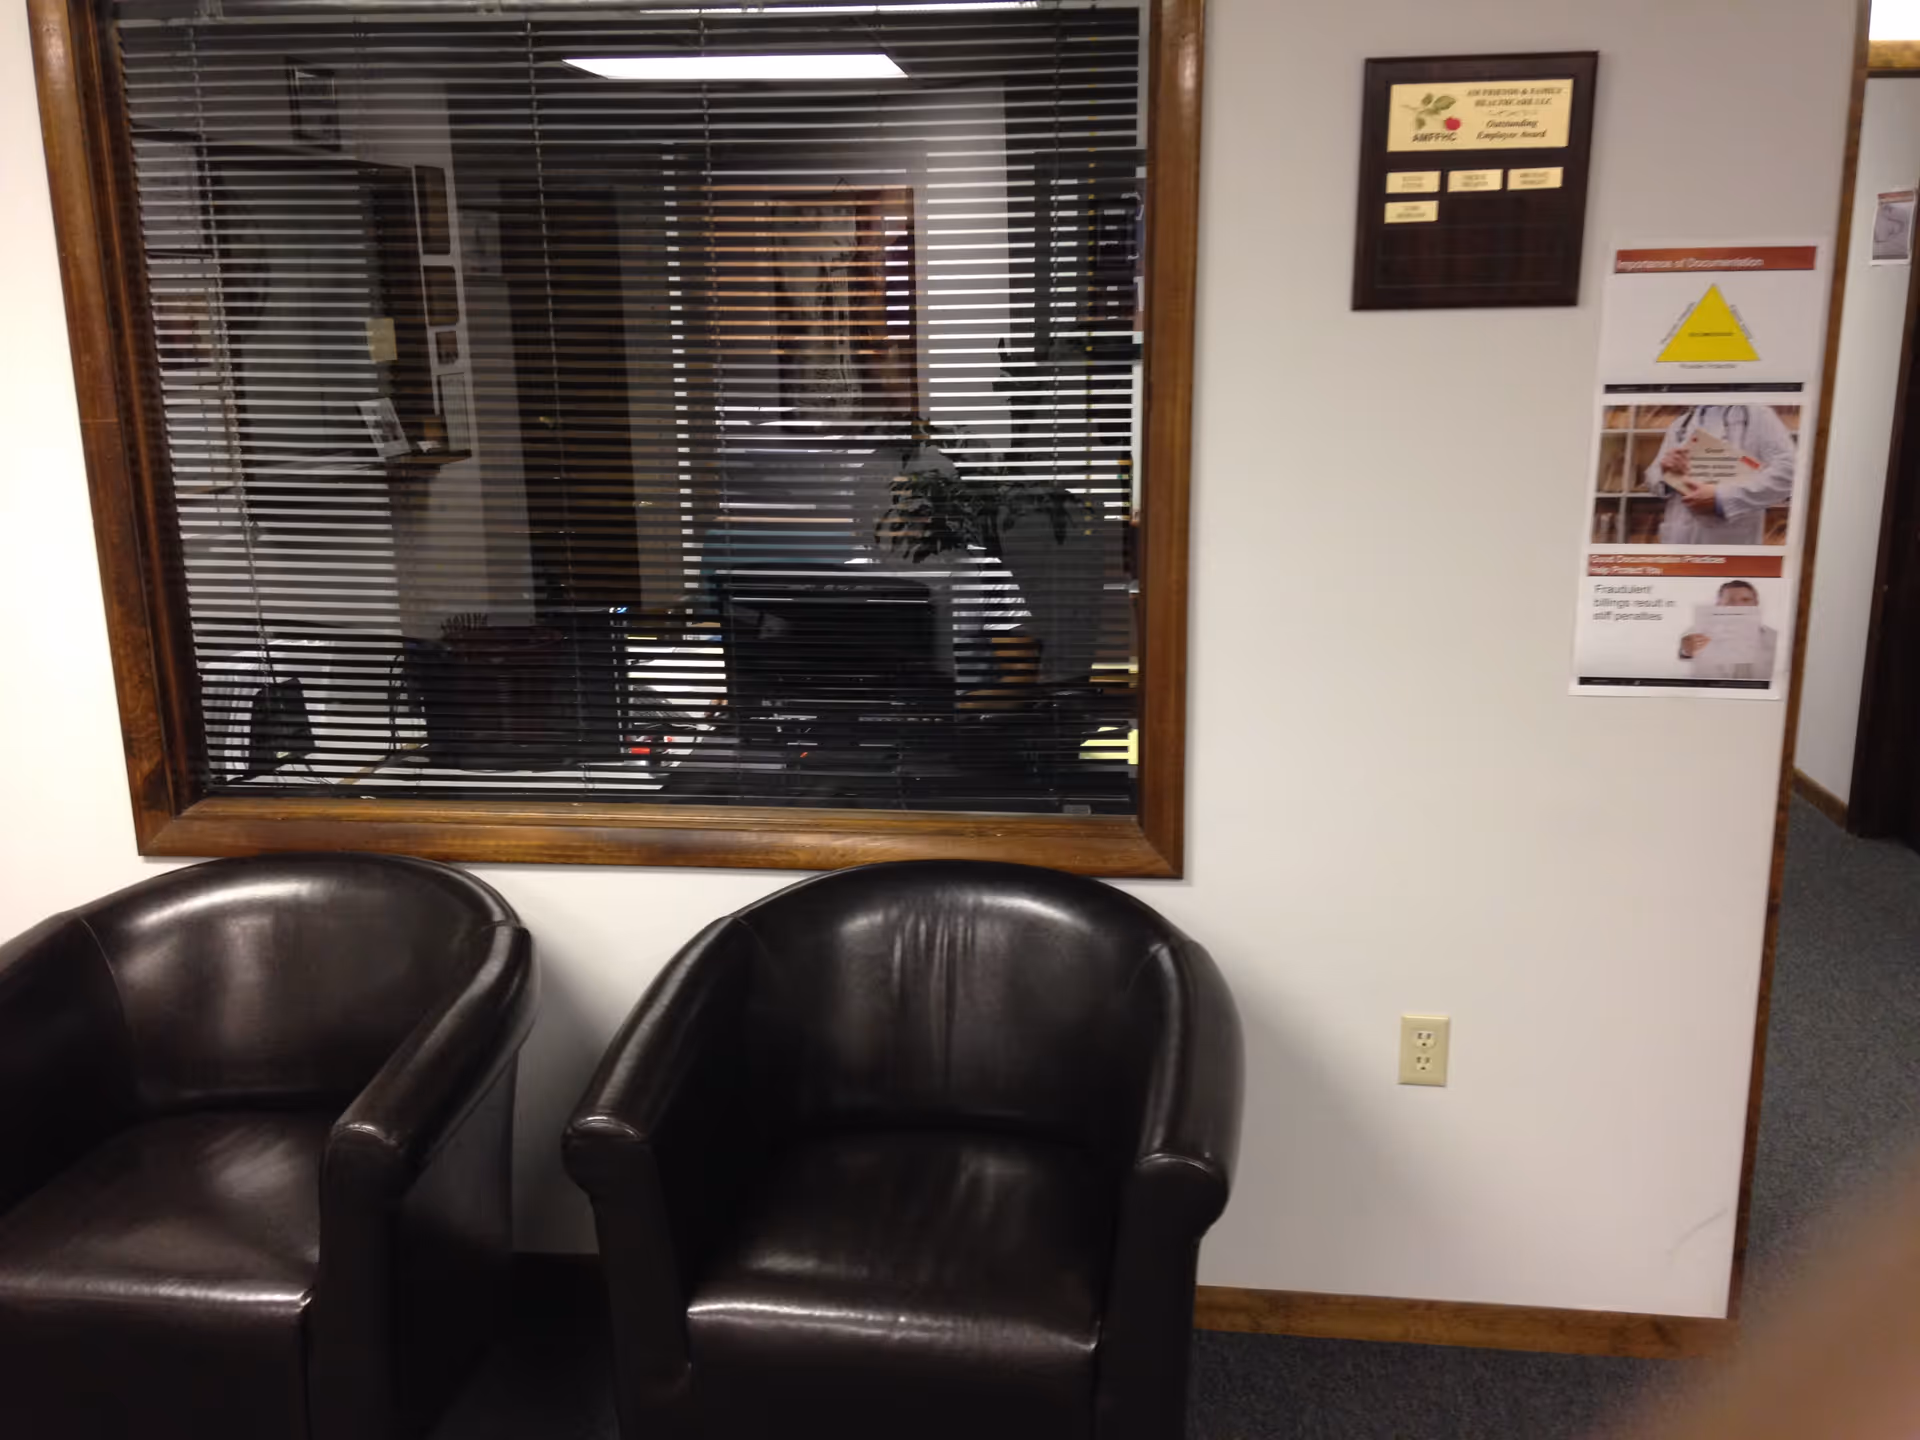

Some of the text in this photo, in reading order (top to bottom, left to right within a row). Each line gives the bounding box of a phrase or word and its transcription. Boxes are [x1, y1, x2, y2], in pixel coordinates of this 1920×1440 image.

[1486, 120, 1539, 129] Outstanding
[1616, 257, 1764, 271] Importance of Documentation
[1617, 555, 1679, 564] Documentation
[1594, 584, 1653, 594] Fraudulent
[1593, 598, 1676, 609] billings result in
[1614, 612, 1663, 622] penalties
